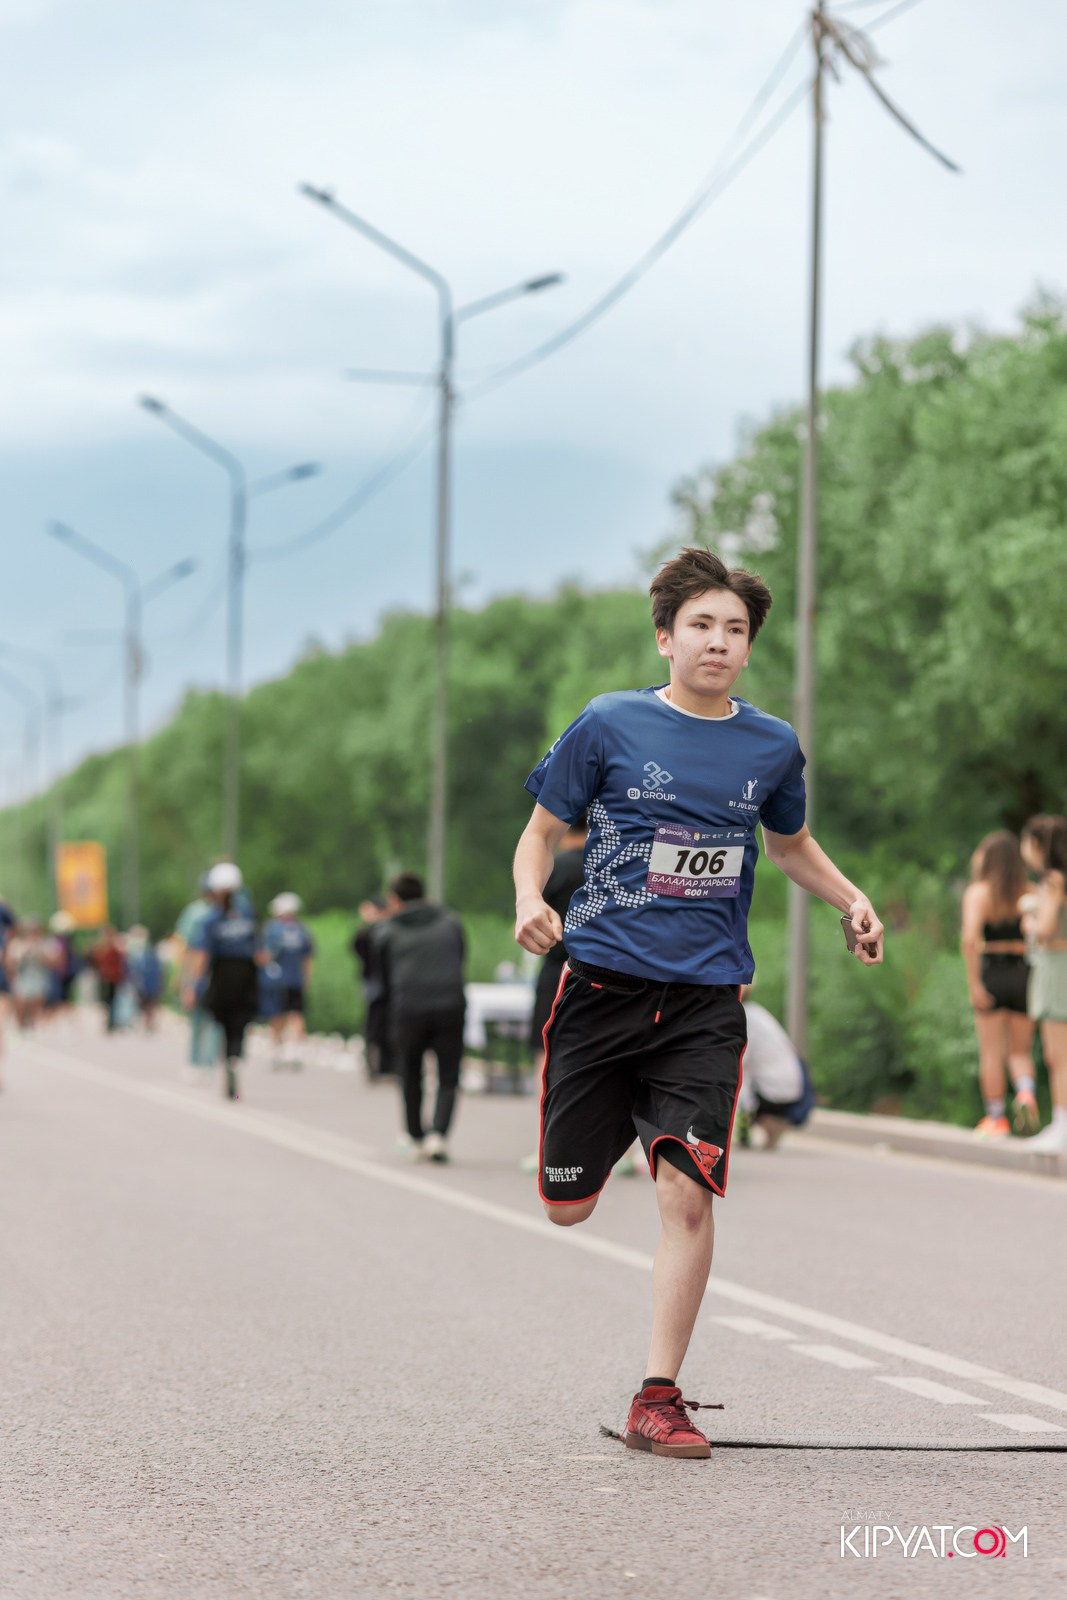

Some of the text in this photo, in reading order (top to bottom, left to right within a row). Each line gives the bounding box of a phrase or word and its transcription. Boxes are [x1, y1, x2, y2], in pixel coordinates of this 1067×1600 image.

[628, 788, 676, 801] BI GROUP
[674, 850, 728, 876] 106
[651, 874, 736, 887] БАЛАЛАР ЖАРЫСЫ
[684, 888, 702, 896] 600
[545, 1166, 583, 1175] CHICAGO
[549, 1174, 577, 1182] BULLS
